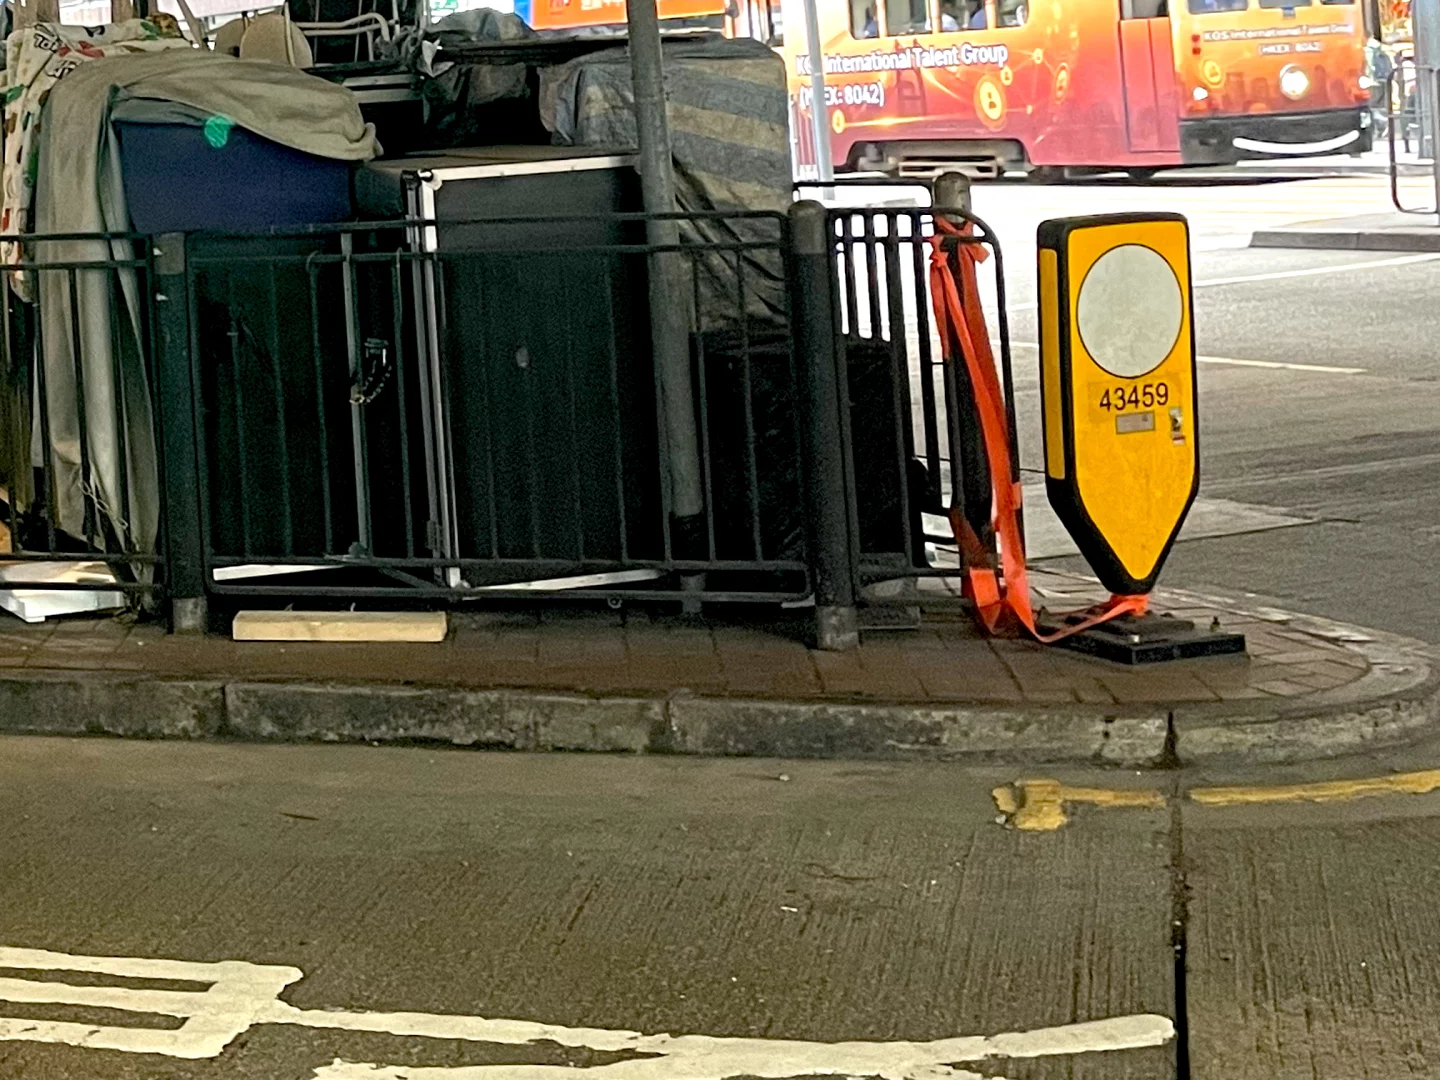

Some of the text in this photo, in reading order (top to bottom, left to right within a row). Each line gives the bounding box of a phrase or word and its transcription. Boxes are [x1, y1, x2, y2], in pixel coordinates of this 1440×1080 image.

[824, 47, 911, 73] International
[913, 44, 959, 67] Talent
[960, 41, 1008, 68] Group
[843, 82, 885, 106] 8042)
[1099, 382, 1169, 412] 43459
